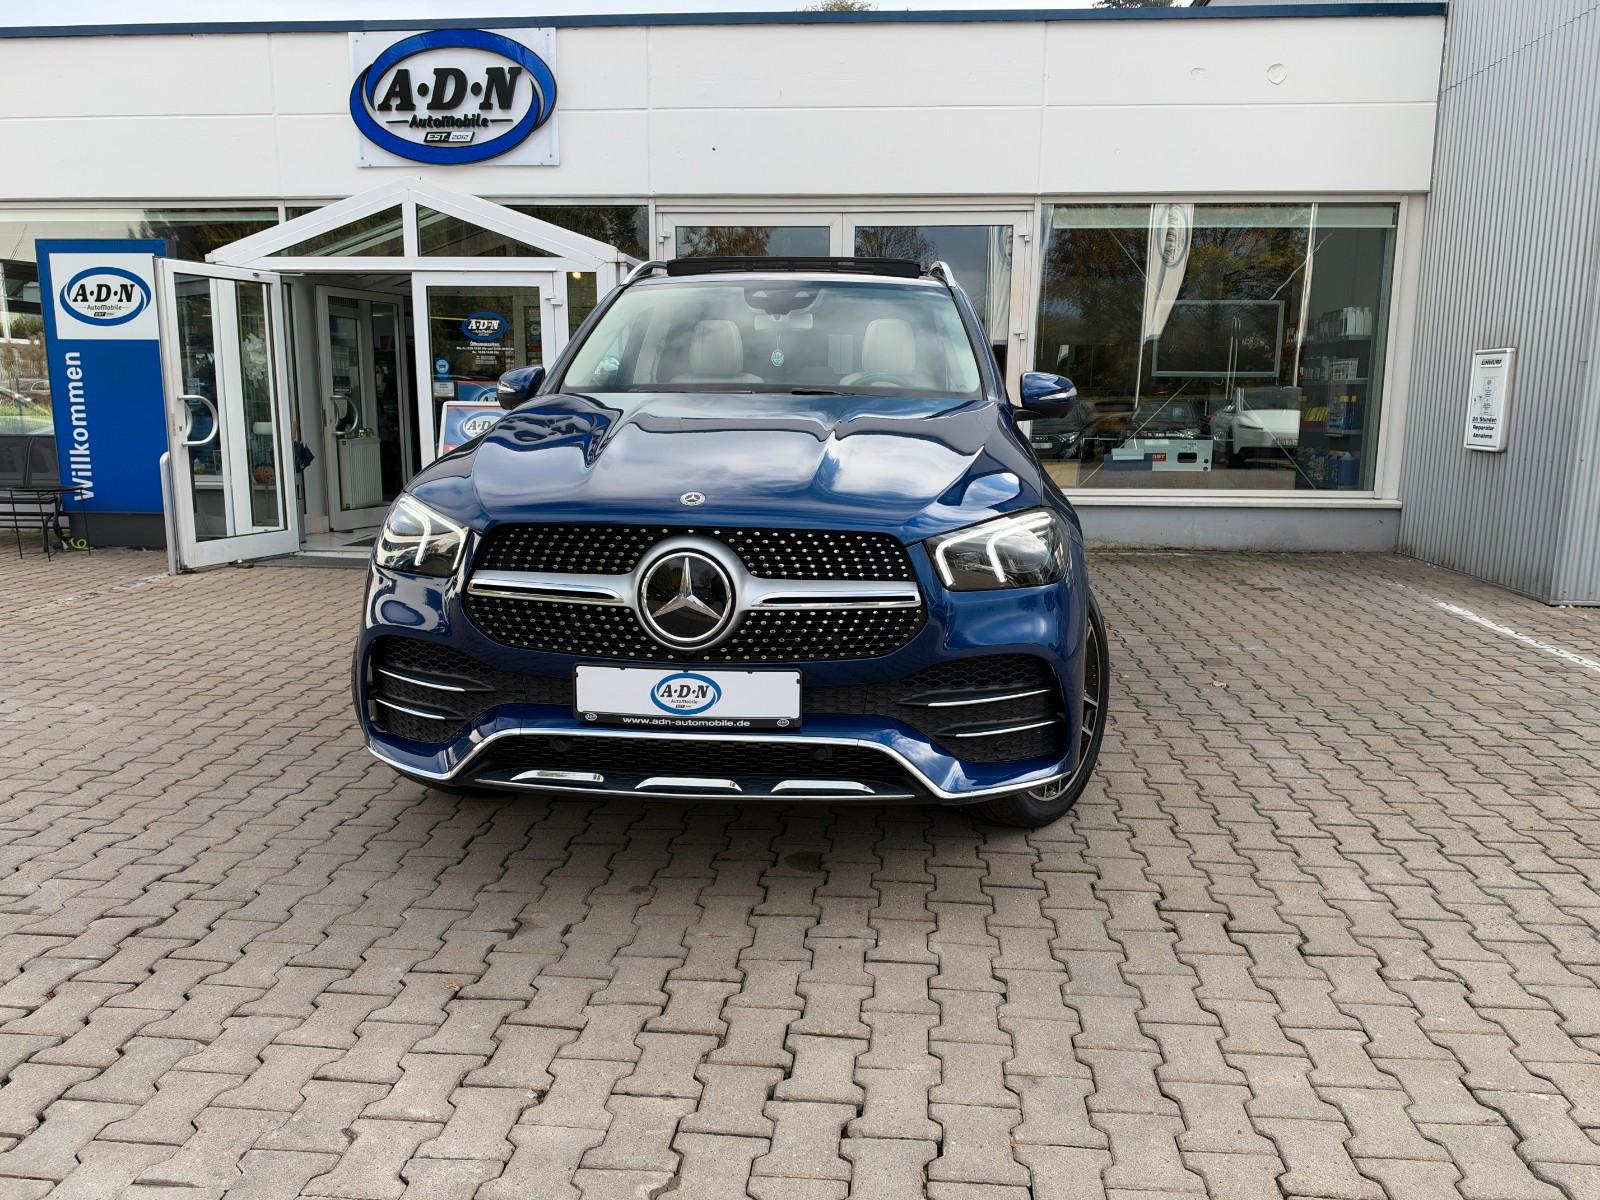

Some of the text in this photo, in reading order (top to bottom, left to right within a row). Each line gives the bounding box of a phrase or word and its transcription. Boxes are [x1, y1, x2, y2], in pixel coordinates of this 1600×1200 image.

[409, 113, 489, 129] AutoMobile
[65, 352, 95, 501] Willkommen
[623, 717, 750, 728] www.adn-automobile.de
